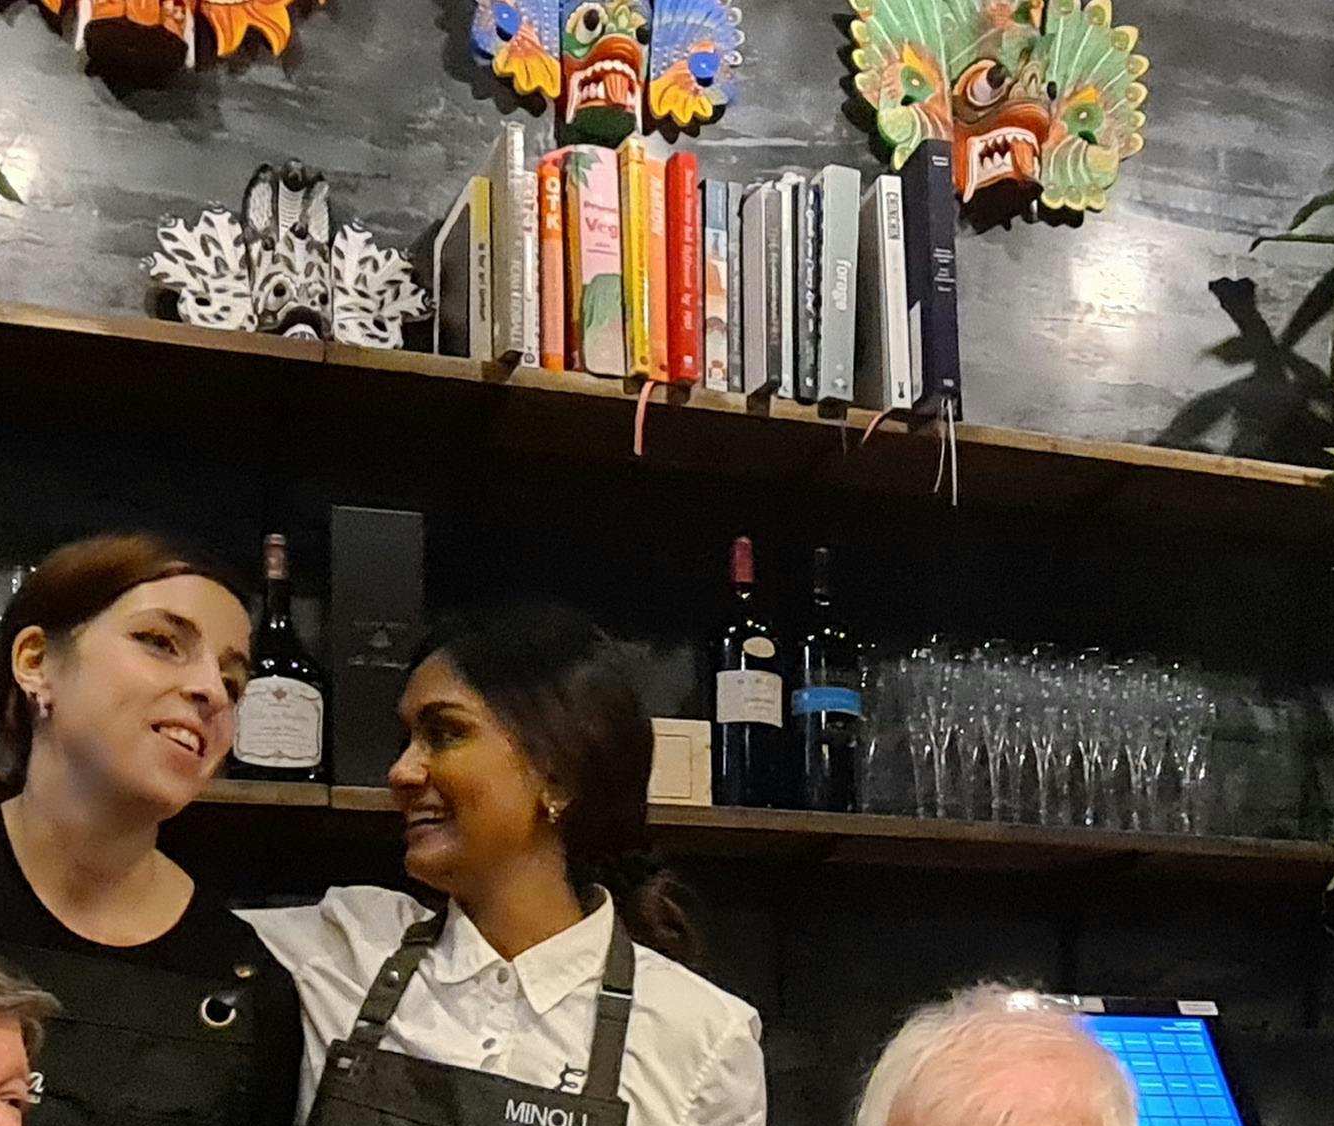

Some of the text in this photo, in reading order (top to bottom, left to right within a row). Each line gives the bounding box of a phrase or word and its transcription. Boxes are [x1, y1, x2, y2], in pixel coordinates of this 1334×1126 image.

[545, 179, 561, 231] OTK
[585, 217, 618, 239] Veg
[831, 259, 852, 311] forage
